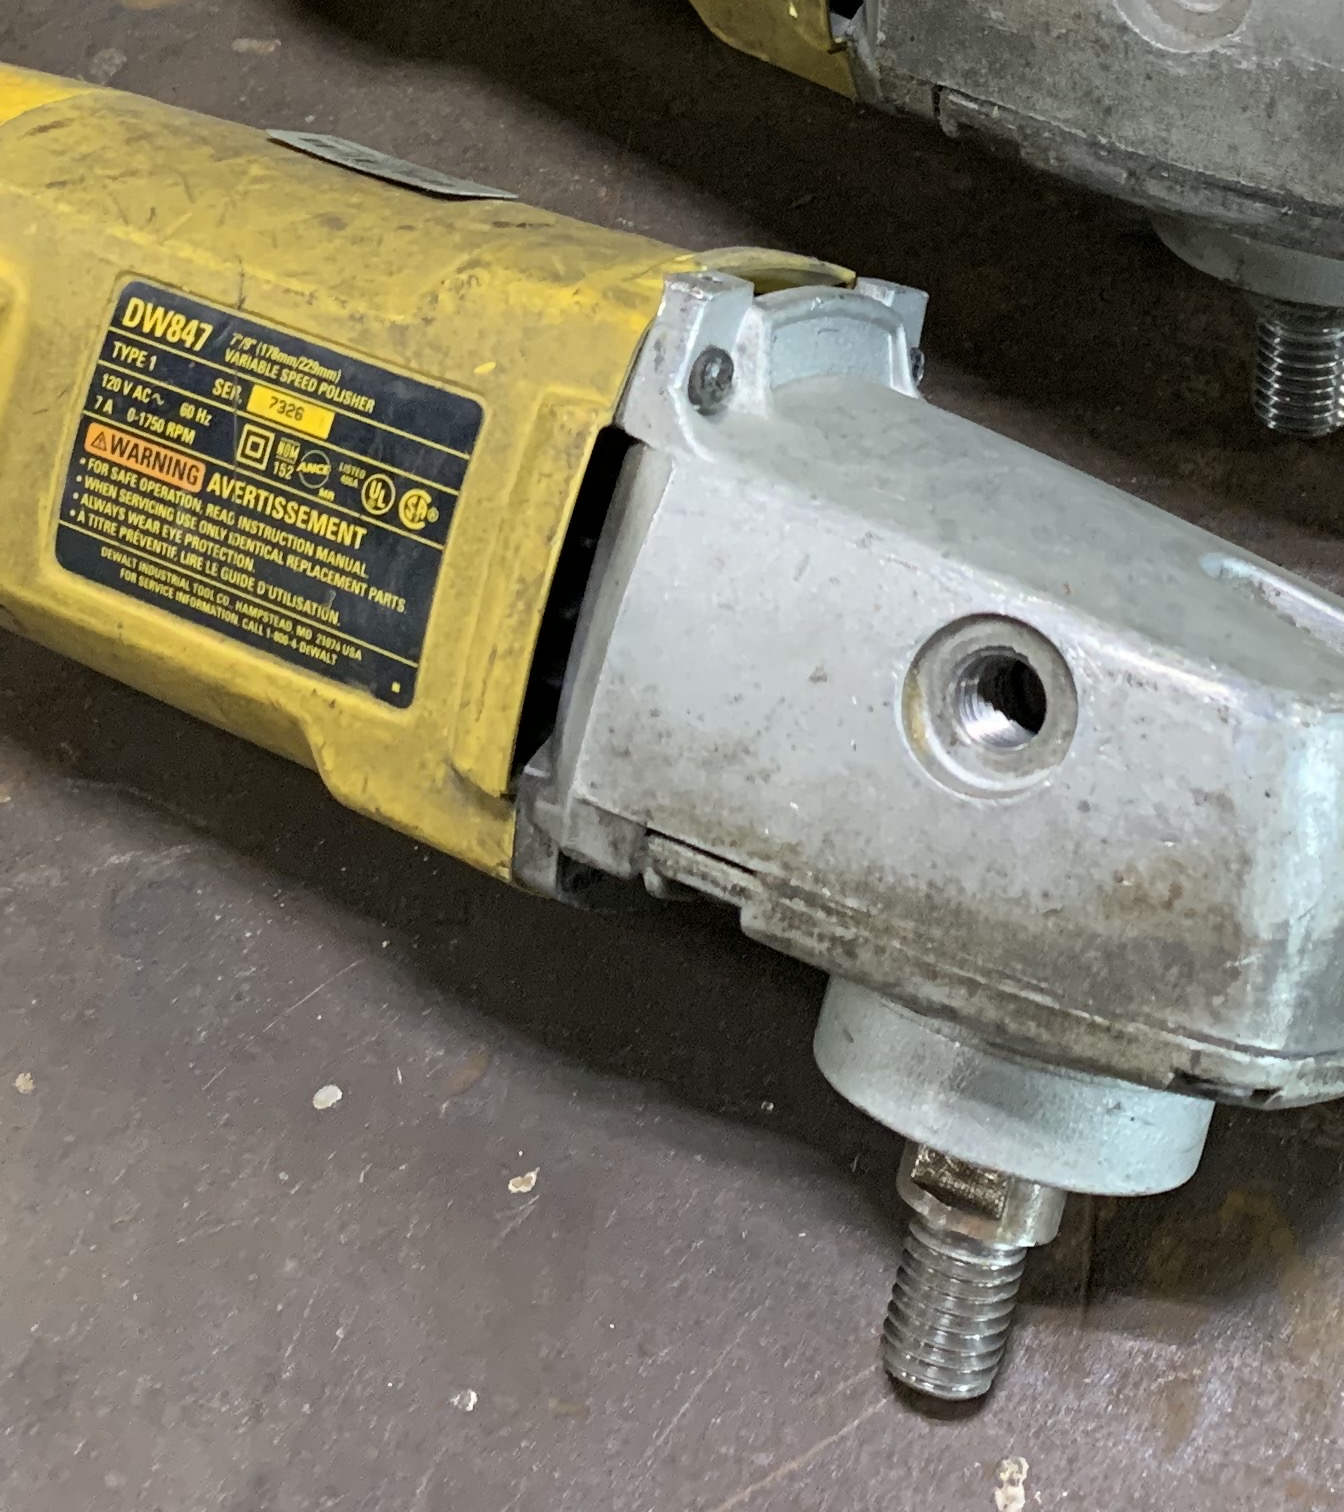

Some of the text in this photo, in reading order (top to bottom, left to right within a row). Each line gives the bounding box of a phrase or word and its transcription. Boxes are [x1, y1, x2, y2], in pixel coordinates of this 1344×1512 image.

[110, 339, 158, 373] TYPE 1
[120, 294, 214, 356] DW847
[99, 371, 122, 393] 120
[177, 400, 196, 421] 60
[194, 406, 213, 428] Hz
[222, 346, 376, 415] VARIABLE SPEED POLISHER
[267, 395, 305, 422] 7326
[92, 393, 196, 446] 7 A 0-1750 RPM
[106, 432, 201, 487] WARNING
[270, 459, 295, 481] 152
[79, 491, 258, 574] ALWAYS WEAR EYE PROTECTION.
[82, 474, 409, 614] WHEN SERVICING USE ONLY IDENTICAL REPLACEMENT PARTS.
[86, 456, 110, 477] FOR
[109, 465, 139, 489] SAFE
[204, 502, 237, 527] READ
[236, 514, 315, 557] INSTRUCTION
[314, 544, 371, 579] MANUAL.
[205, 469, 368, 553] AVERTISSEMENT
[86, 512, 118, 537] TITRE
[178, 549, 205, 572] LIRE
[203, 558, 219, 577] LE
[219, 565, 255, 592] GUIDE
[117, 567, 138, 585] FOR
[136, 574, 175, 600] SERVICE
[240, 616, 266, 637] CALL
[136, 559, 192, 592] INDUSTRIAL
[191, 581, 216, 602] TOOL
[294, 623, 314, 641] MD
[340, 641, 364, 661] USA
